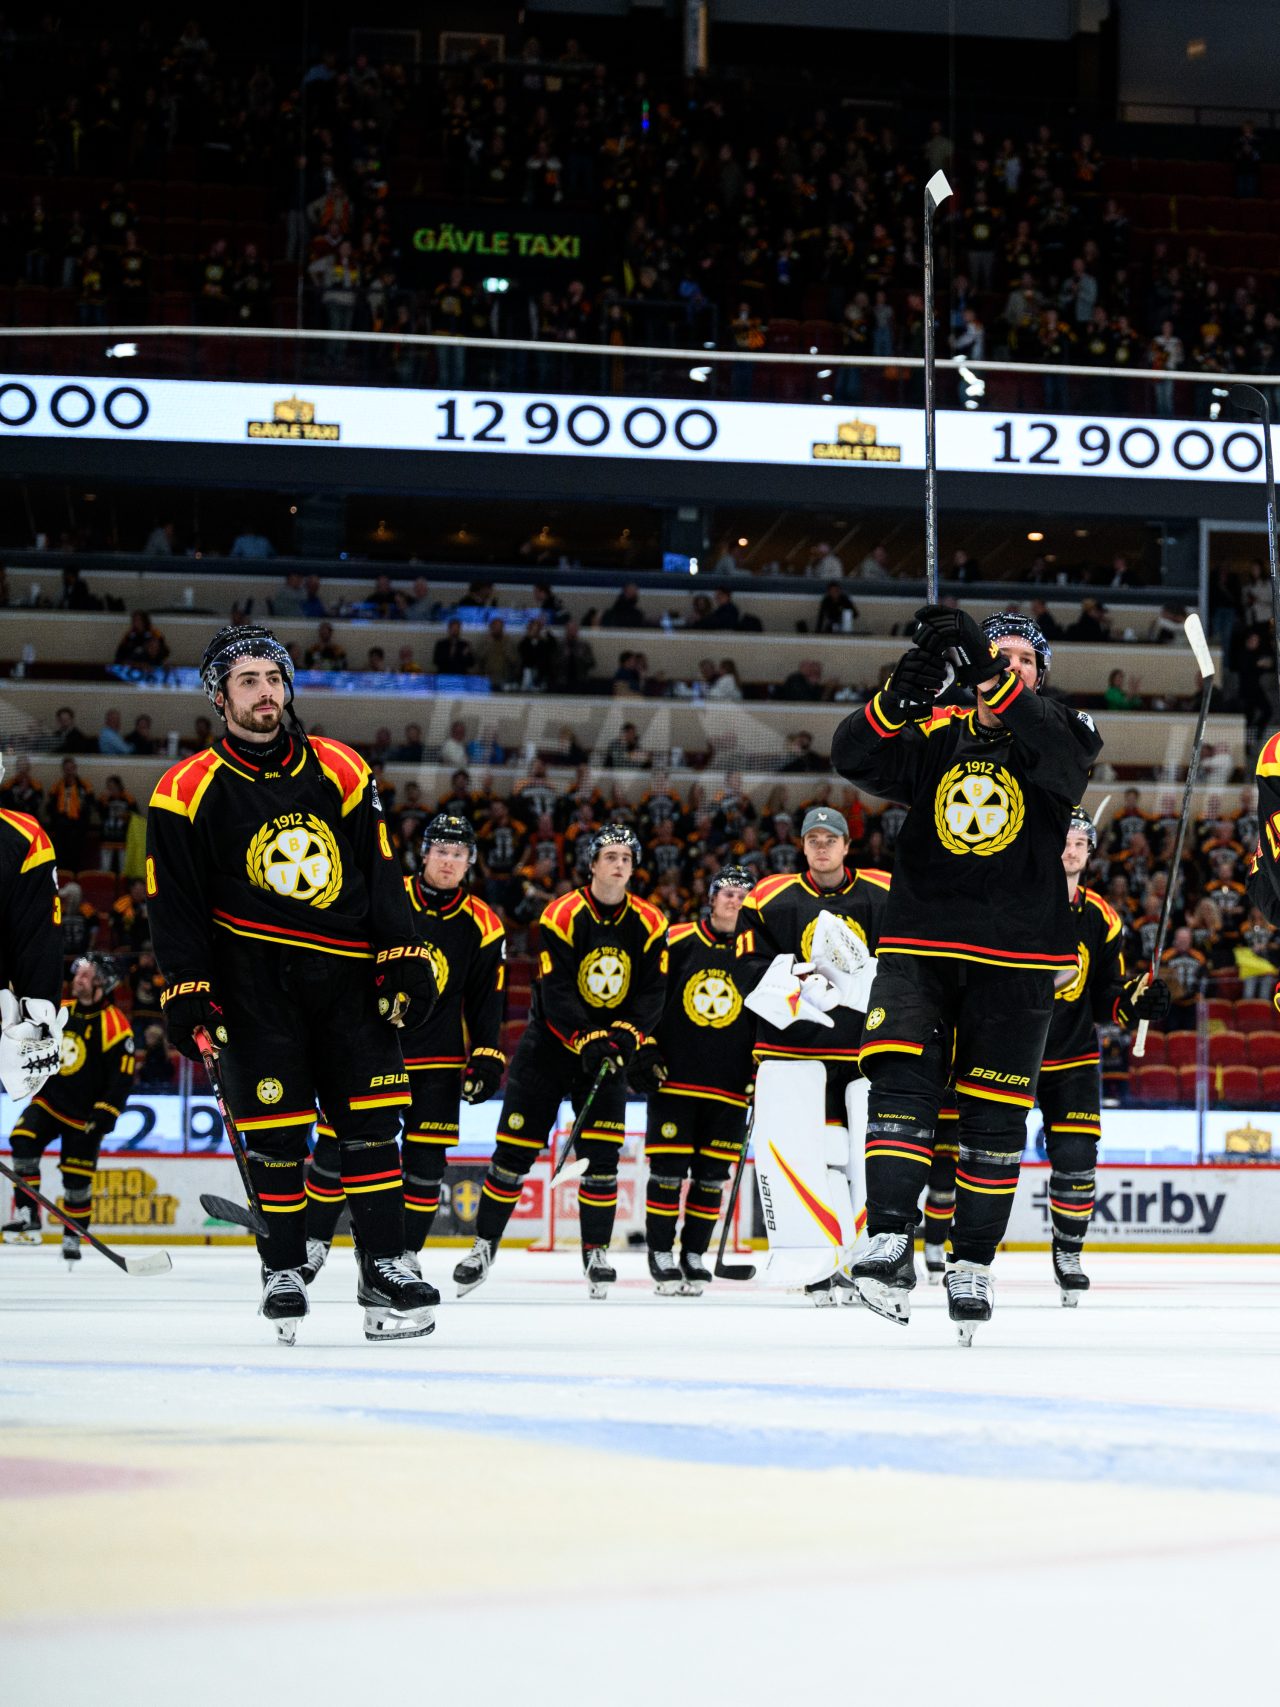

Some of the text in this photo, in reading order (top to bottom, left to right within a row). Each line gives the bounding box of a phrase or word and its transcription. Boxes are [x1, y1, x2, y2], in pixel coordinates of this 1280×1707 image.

[412, 223, 581, 258] GÄVLE TAXI
[265, 771, 281, 780] SHL
[965, 761, 995, 775] 1912
[273, 812, 304, 830] 1912
[376, 946, 433, 964] BAUE
[540, 950, 553, 975] 8
[160, 980, 211, 1010] AUER
[369, 1073, 410, 1088] BAUE
[969, 1066, 1032, 1088] BAUER
[593, 1120, 625, 1131] BAUE
[1066, 1111, 1101, 1122] BAUE
[91, 1169, 144, 1197] URO
[760, 1174, 776, 1231] BAUER
[1094, 1181, 1227, 1233] kirby
